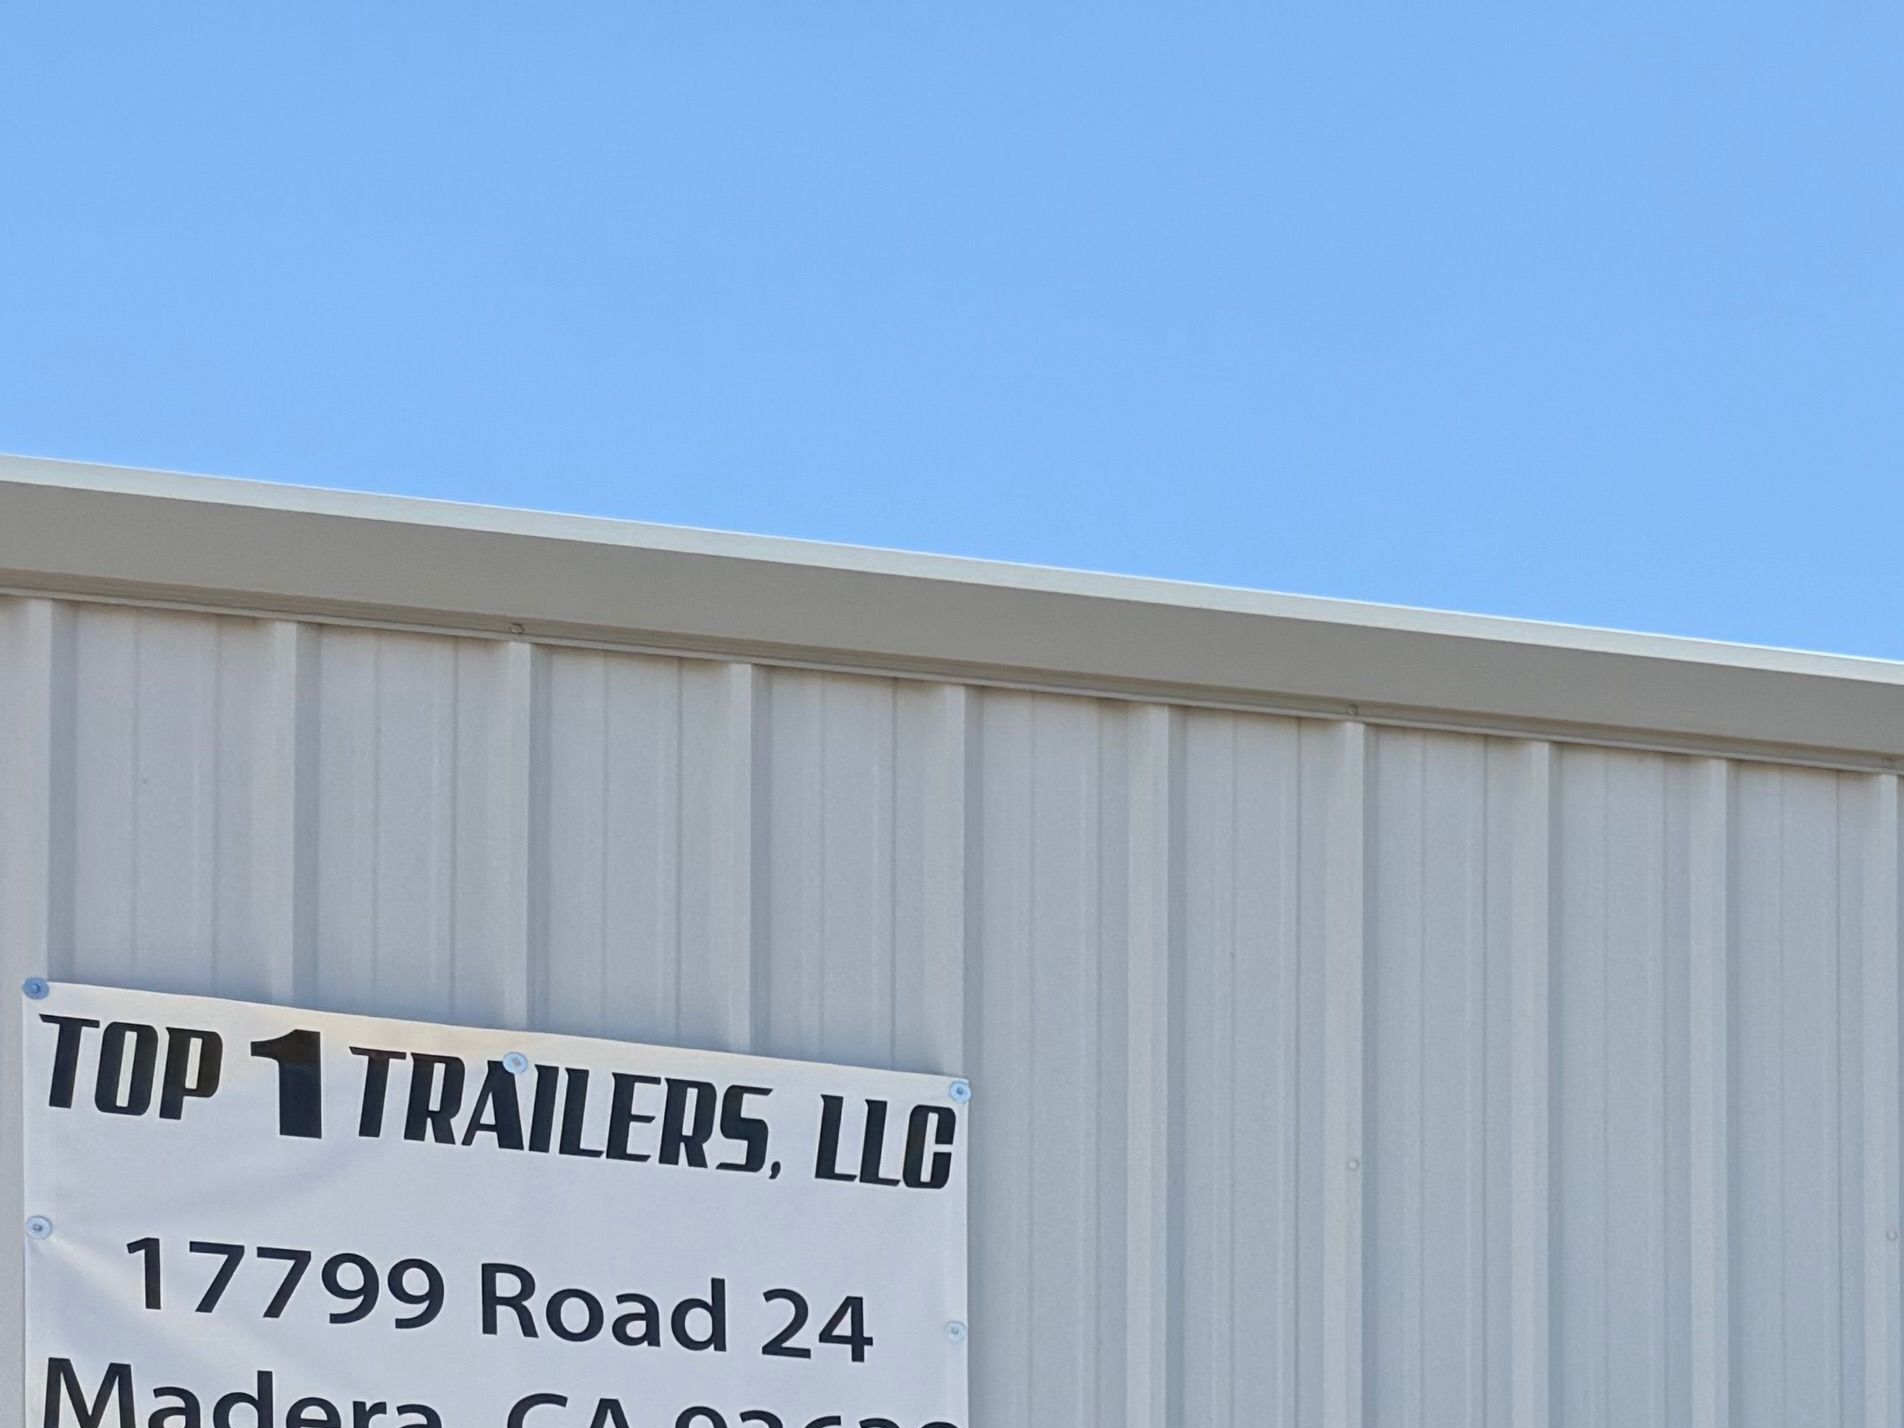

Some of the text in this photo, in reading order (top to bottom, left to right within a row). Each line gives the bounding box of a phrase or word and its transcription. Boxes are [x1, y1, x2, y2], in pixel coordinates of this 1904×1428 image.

[39, 1013, 957, 1190] TOP 1 TRAILERS, LLC
[126, 1237, 874, 1363] 17799 Road 24
